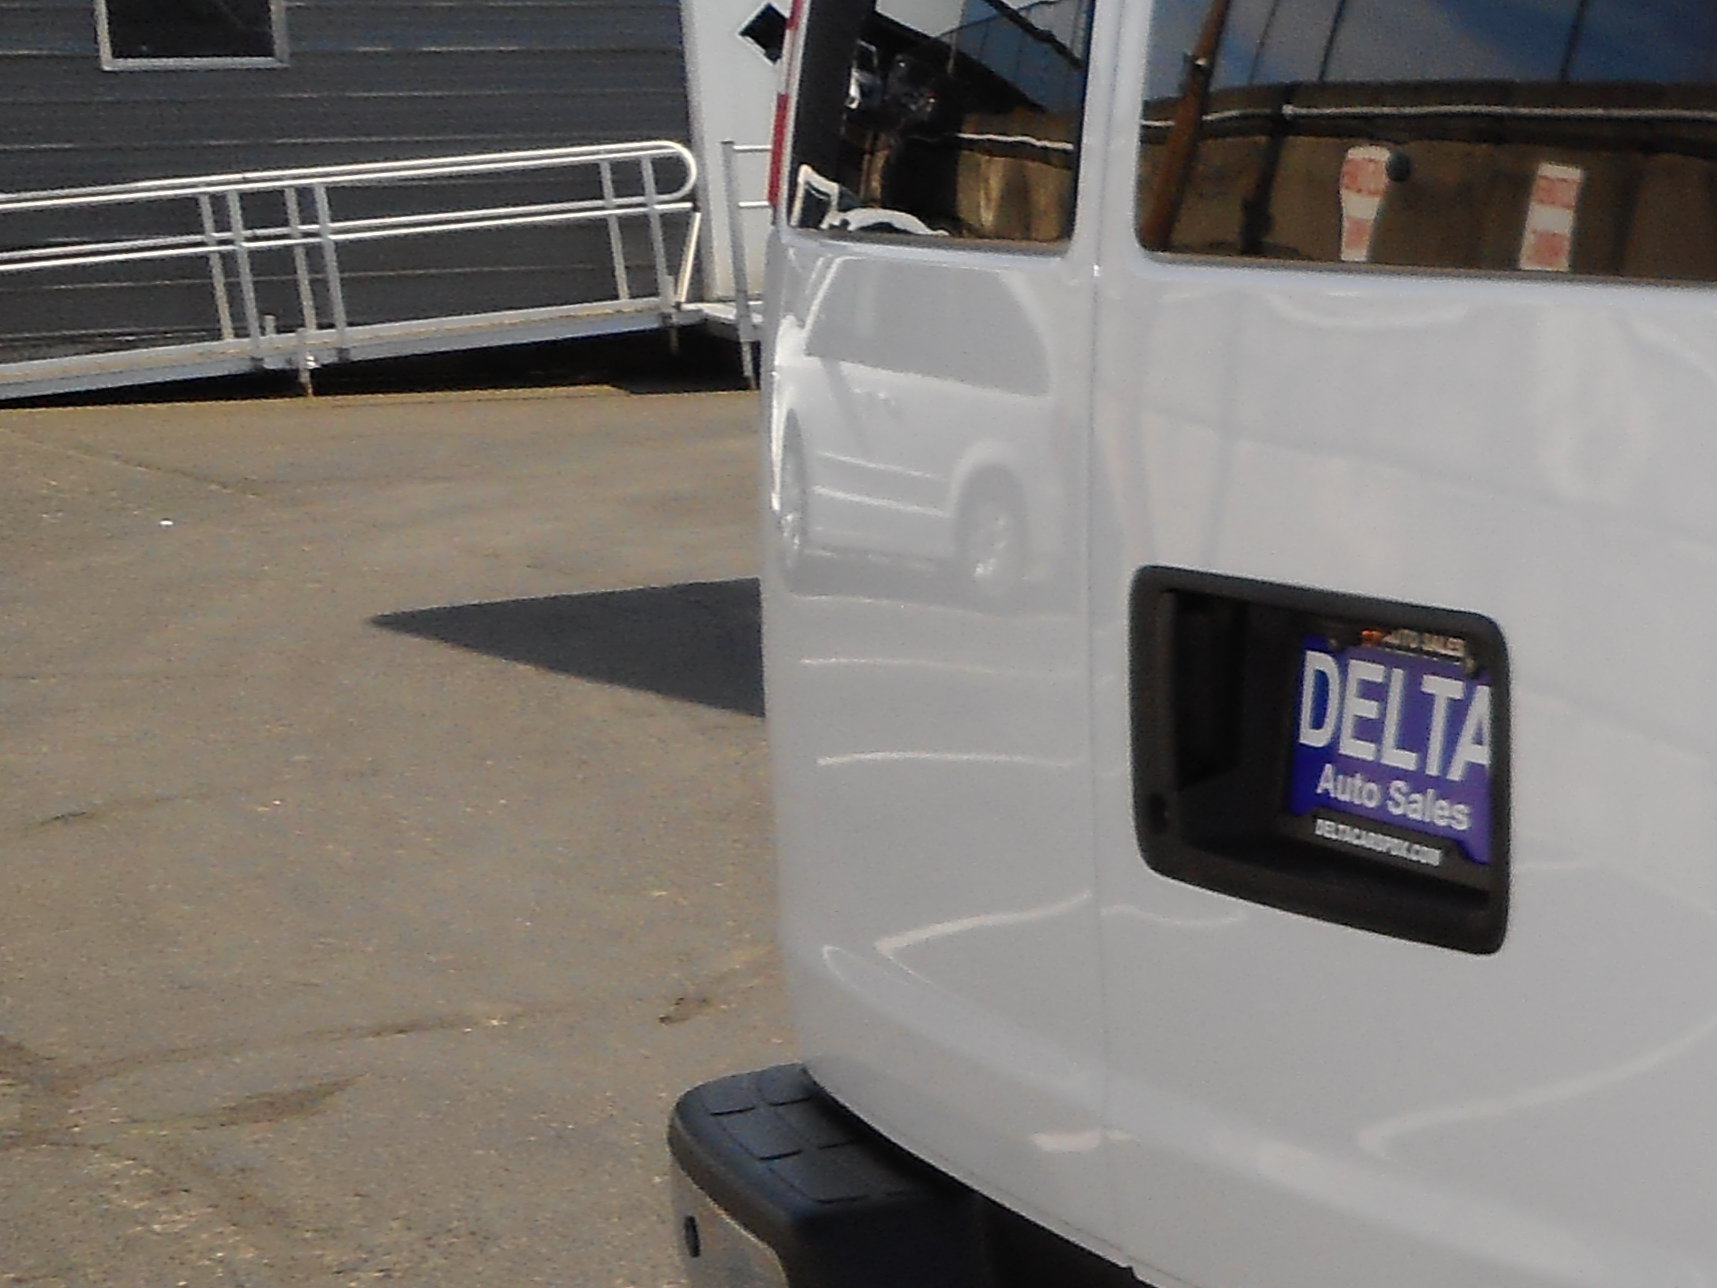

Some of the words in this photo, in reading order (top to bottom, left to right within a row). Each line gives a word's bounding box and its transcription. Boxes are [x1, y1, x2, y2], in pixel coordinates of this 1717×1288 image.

[1300, 650, 1492, 781] DELTA
[1316, 763, 1381, 808] Auto
[1386, 780, 1471, 830] Sales
